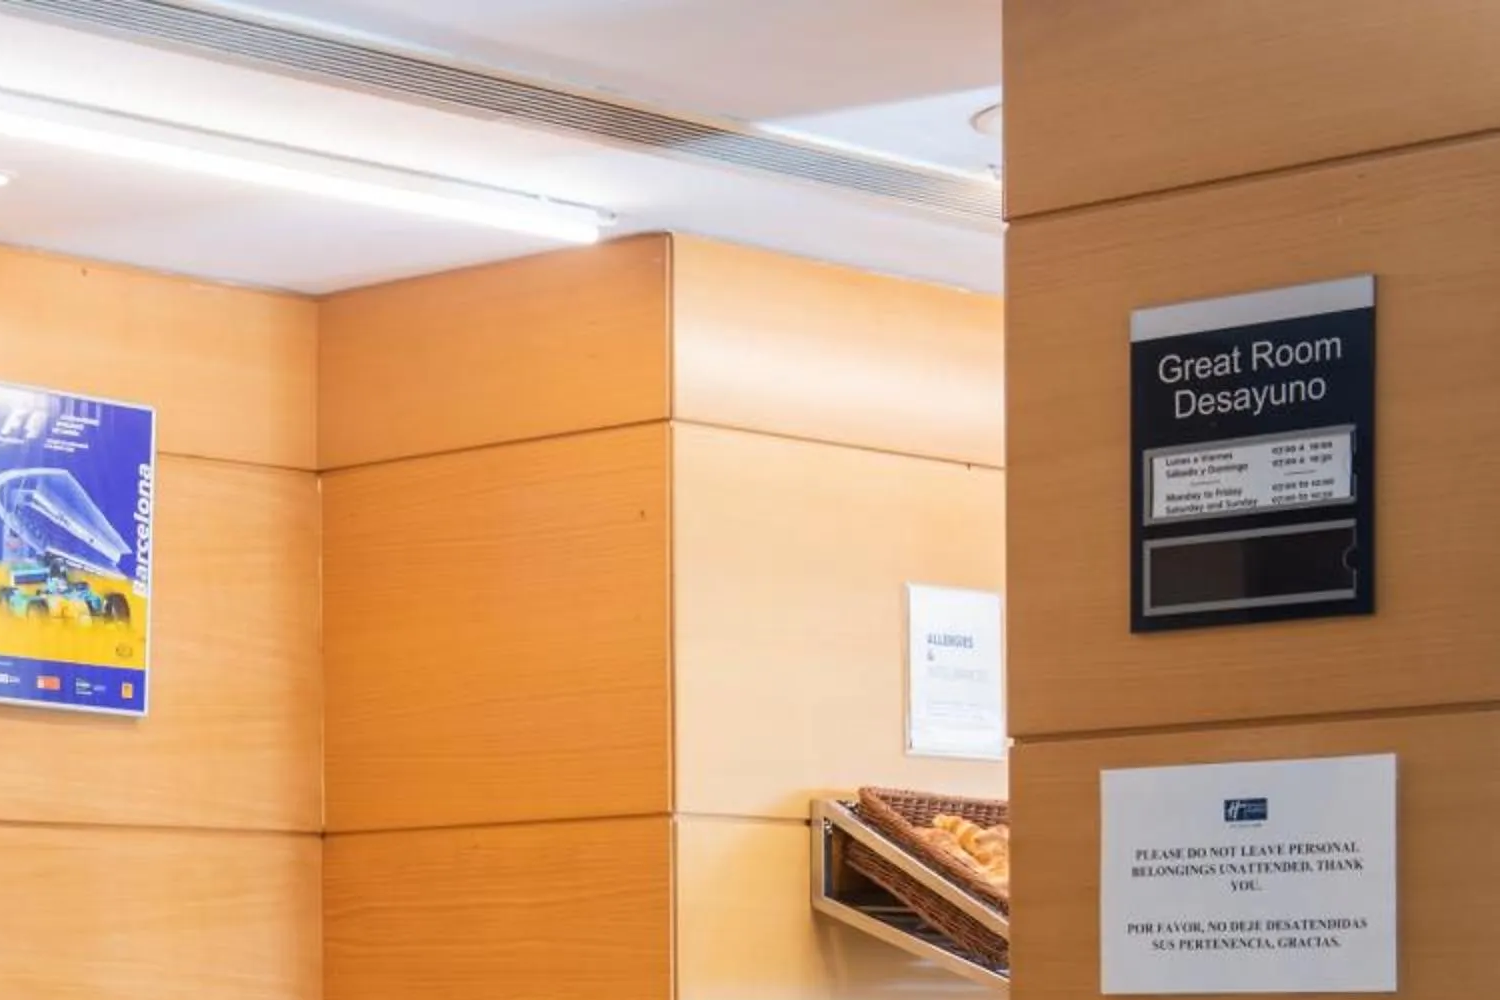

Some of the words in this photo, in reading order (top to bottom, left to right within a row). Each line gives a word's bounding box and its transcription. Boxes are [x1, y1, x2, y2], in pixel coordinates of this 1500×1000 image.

[1158, 345, 1242, 383] Great
[1251, 336, 1342, 371] Room
[1174, 376, 1328, 420] Desayuno
[1207, 463, 1249, 474] Domingo
[1135, 848, 1182, 861] PLEASE
[1186, 846, 1207, 859] DO
[1209, 846, 1236, 858] NOT
[1240, 844, 1284, 857] LEAVE
[1288, 840, 1359, 856] PERSONAL
[1130, 863, 1217, 878] BELONGINGS
[1316, 857, 1363, 872] THANK
[1126, 922, 1154, 935] POR
[1156, 920, 1205, 934] FAVOR,
[1207, 920, 1227, 933] NO
[1229, 919, 1263, 932] DEJE
[1265, 917, 1369, 931] DESATENDIDAS
[1151, 939, 1176, 951] SUS
